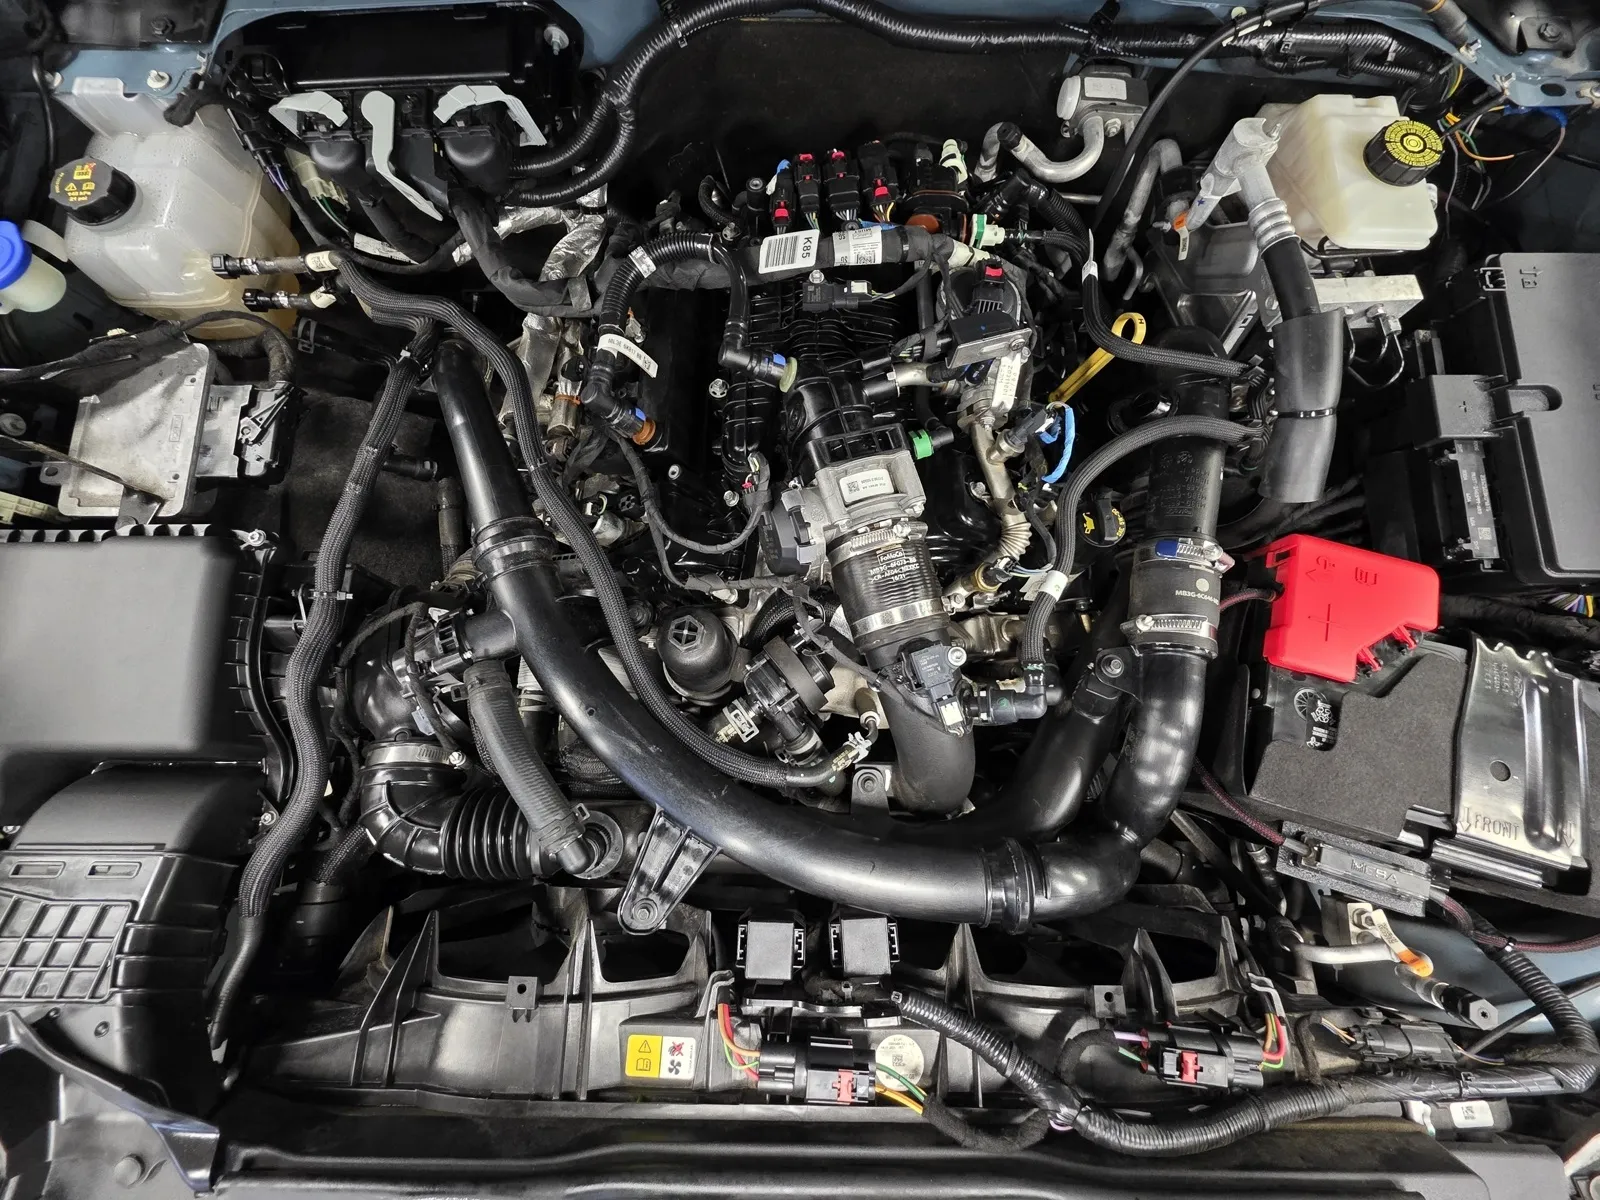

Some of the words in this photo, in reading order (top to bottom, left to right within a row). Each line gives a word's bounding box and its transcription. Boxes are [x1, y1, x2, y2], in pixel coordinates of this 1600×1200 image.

[801, 236, 813, 259] K85
[881, 551, 903, 562] FoMoCo
[1475, 813, 1520, 841] FRONT
